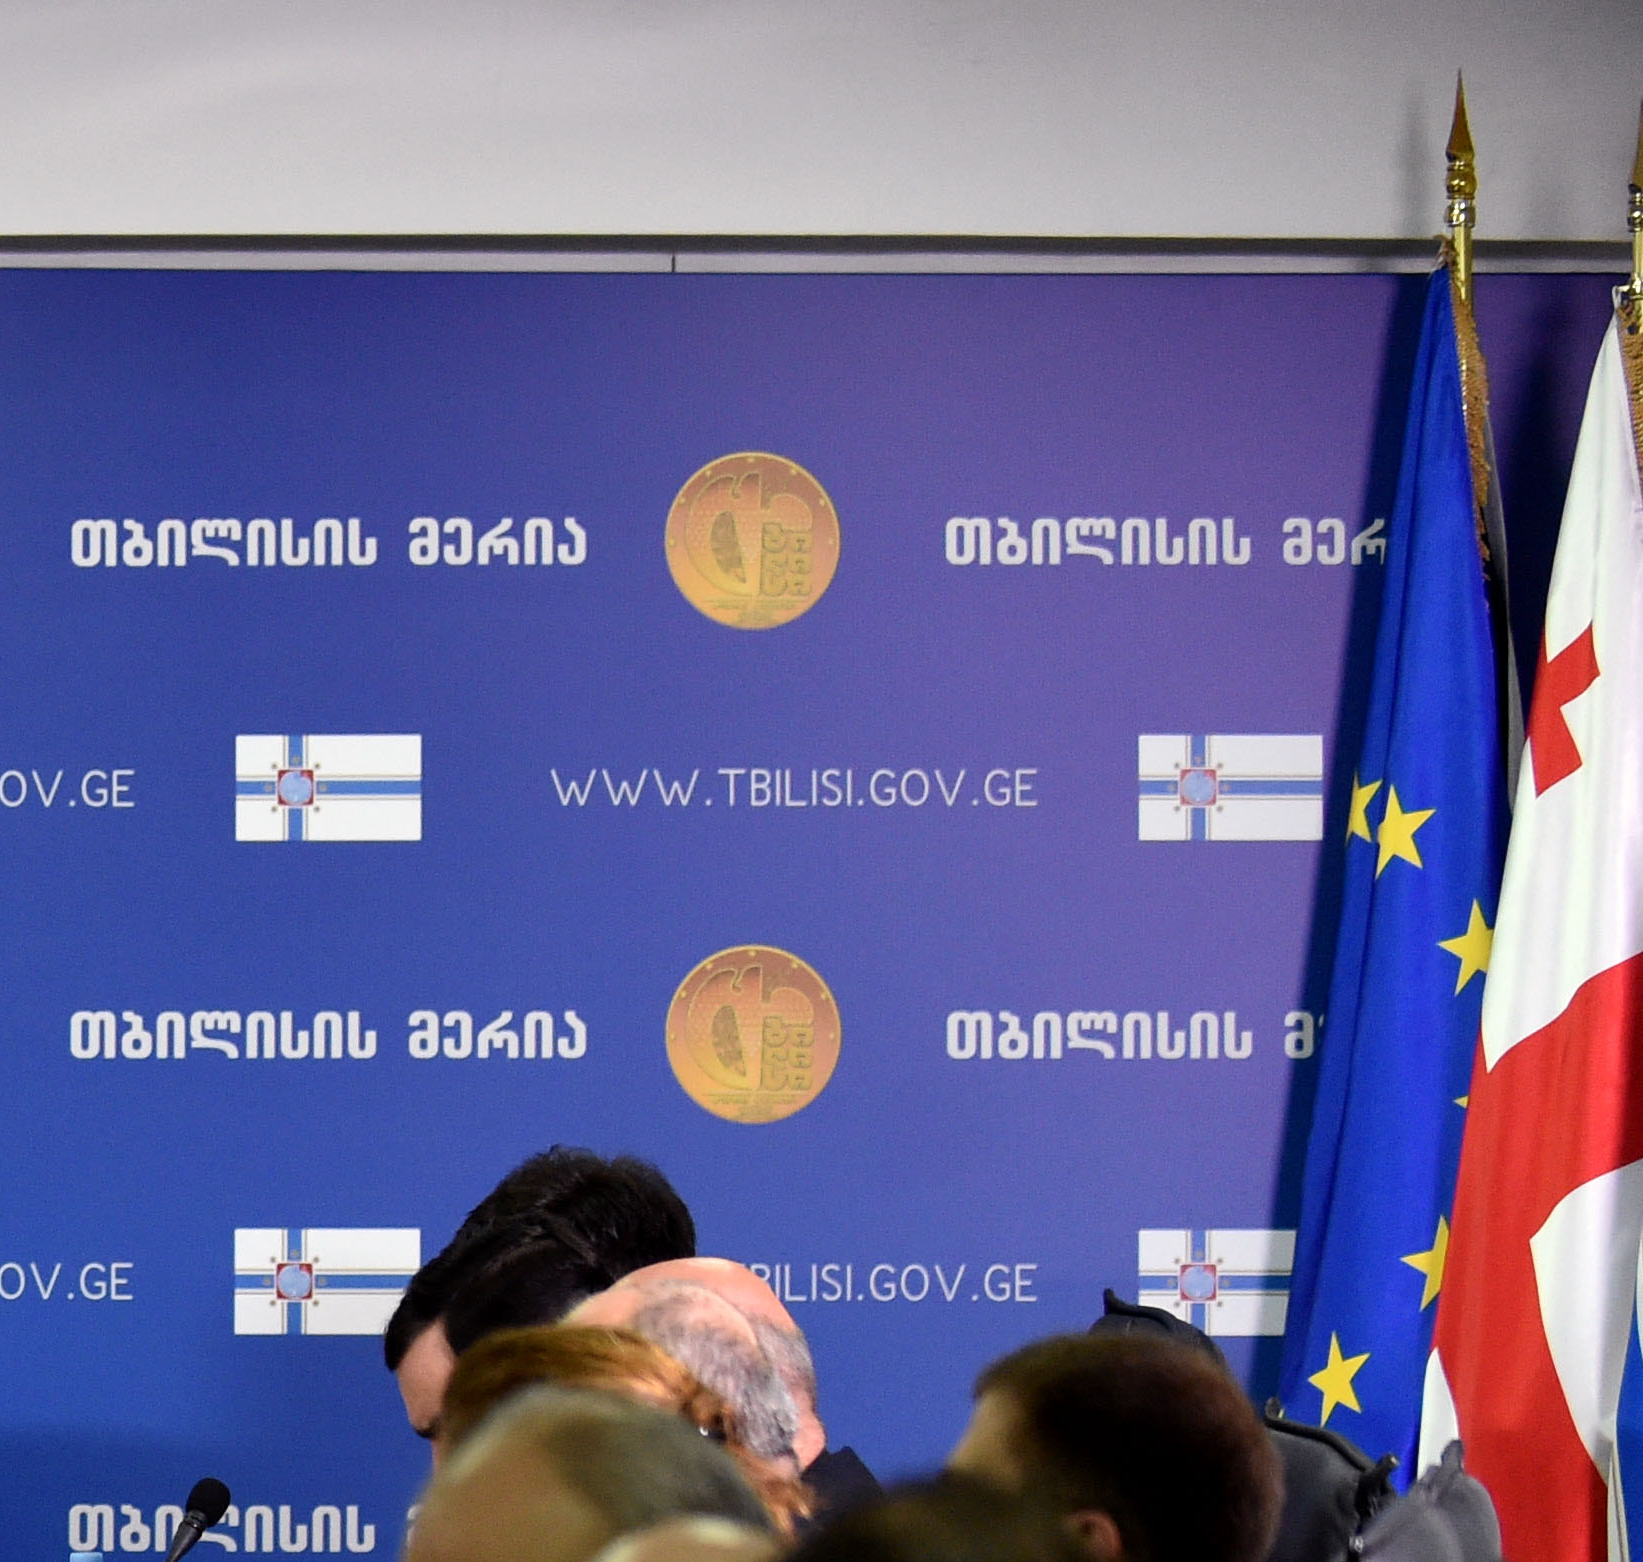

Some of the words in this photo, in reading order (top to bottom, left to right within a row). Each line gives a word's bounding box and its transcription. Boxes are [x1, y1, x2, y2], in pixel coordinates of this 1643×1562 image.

[71, 517, 378, 568] თბილისის
[408, 516, 588, 566] მერია
[944, 516, 1252, 566] თბილისის
[1282, 516, 1387, 566] მერ
[549, 767, 1039, 807] WWW.TBILISI.GOV.GE
[70, 1010, 377, 1059] თბილისის
[408, 1009, 588, 1059] მერია
[946, 1009, 1254, 1060] თბილისის
